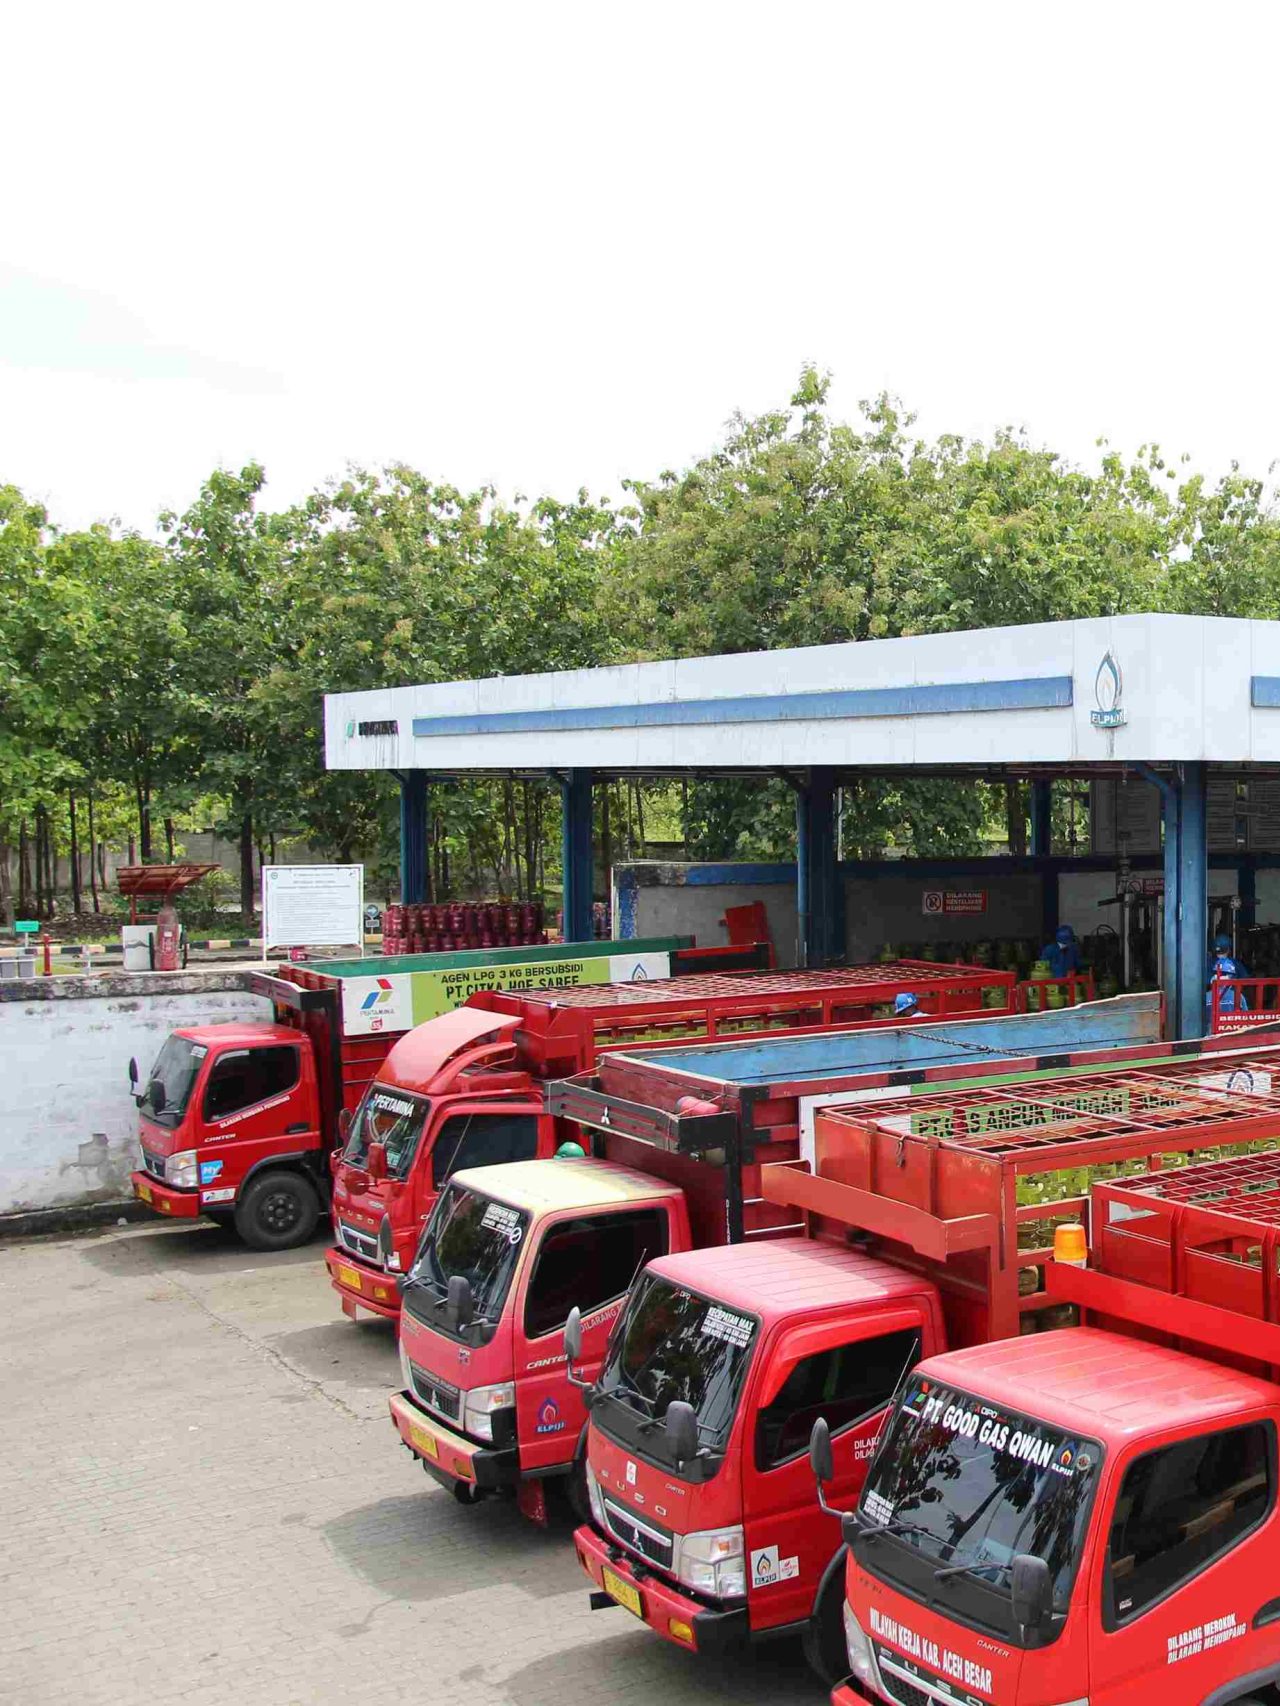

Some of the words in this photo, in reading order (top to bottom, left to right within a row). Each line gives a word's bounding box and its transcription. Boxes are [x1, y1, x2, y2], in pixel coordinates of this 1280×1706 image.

[441, 973, 470, 984] AGEN
[473, 971, 495, 981] LPG
[499, 970, 507, 979] 3
[509, 969, 522, 978] KG
[525, 963, 584, 977] BERSUBSIDI
[376, 1094, 415, 1117] PERTAMINA
[204, 1133, 236, 1143] CANTER
[707, 1307, 740, 1326] KECEPATAN
[738, 1317, 755, 1331] MAX
[526, 1354, 568, 1370] CANTE
[537, 1421, 565, 1433] ELPIJI
[922, 1397, 944, 1424] PT.
[942, 1405, 980, 1438] GOOD
[979, 1418, 1010, 1451] GAS
[1008, 1430, 1055, 1468] QWAN
[664, 1482, 685, 1496] CANTER
[1167, 1627, 1203, 1652] DILARANG
[1203, 1612, 1236, 1636] MEROKOK
[869, 1606, 898, 1645] WILAYAH
[897, 1624, 920, 1657] KERJA
[921, 1638, 941, 1669] KAB.
[942, 1649, 963, 1681] ACEH
[963, 1660, 992, 1694] BESAR
[976, 1639, 1010, 1658] CANTER
[1167, 1641, 1202, 1664] DILARANG
[1203, 1623, 1247, 1650] MENUMPANG
